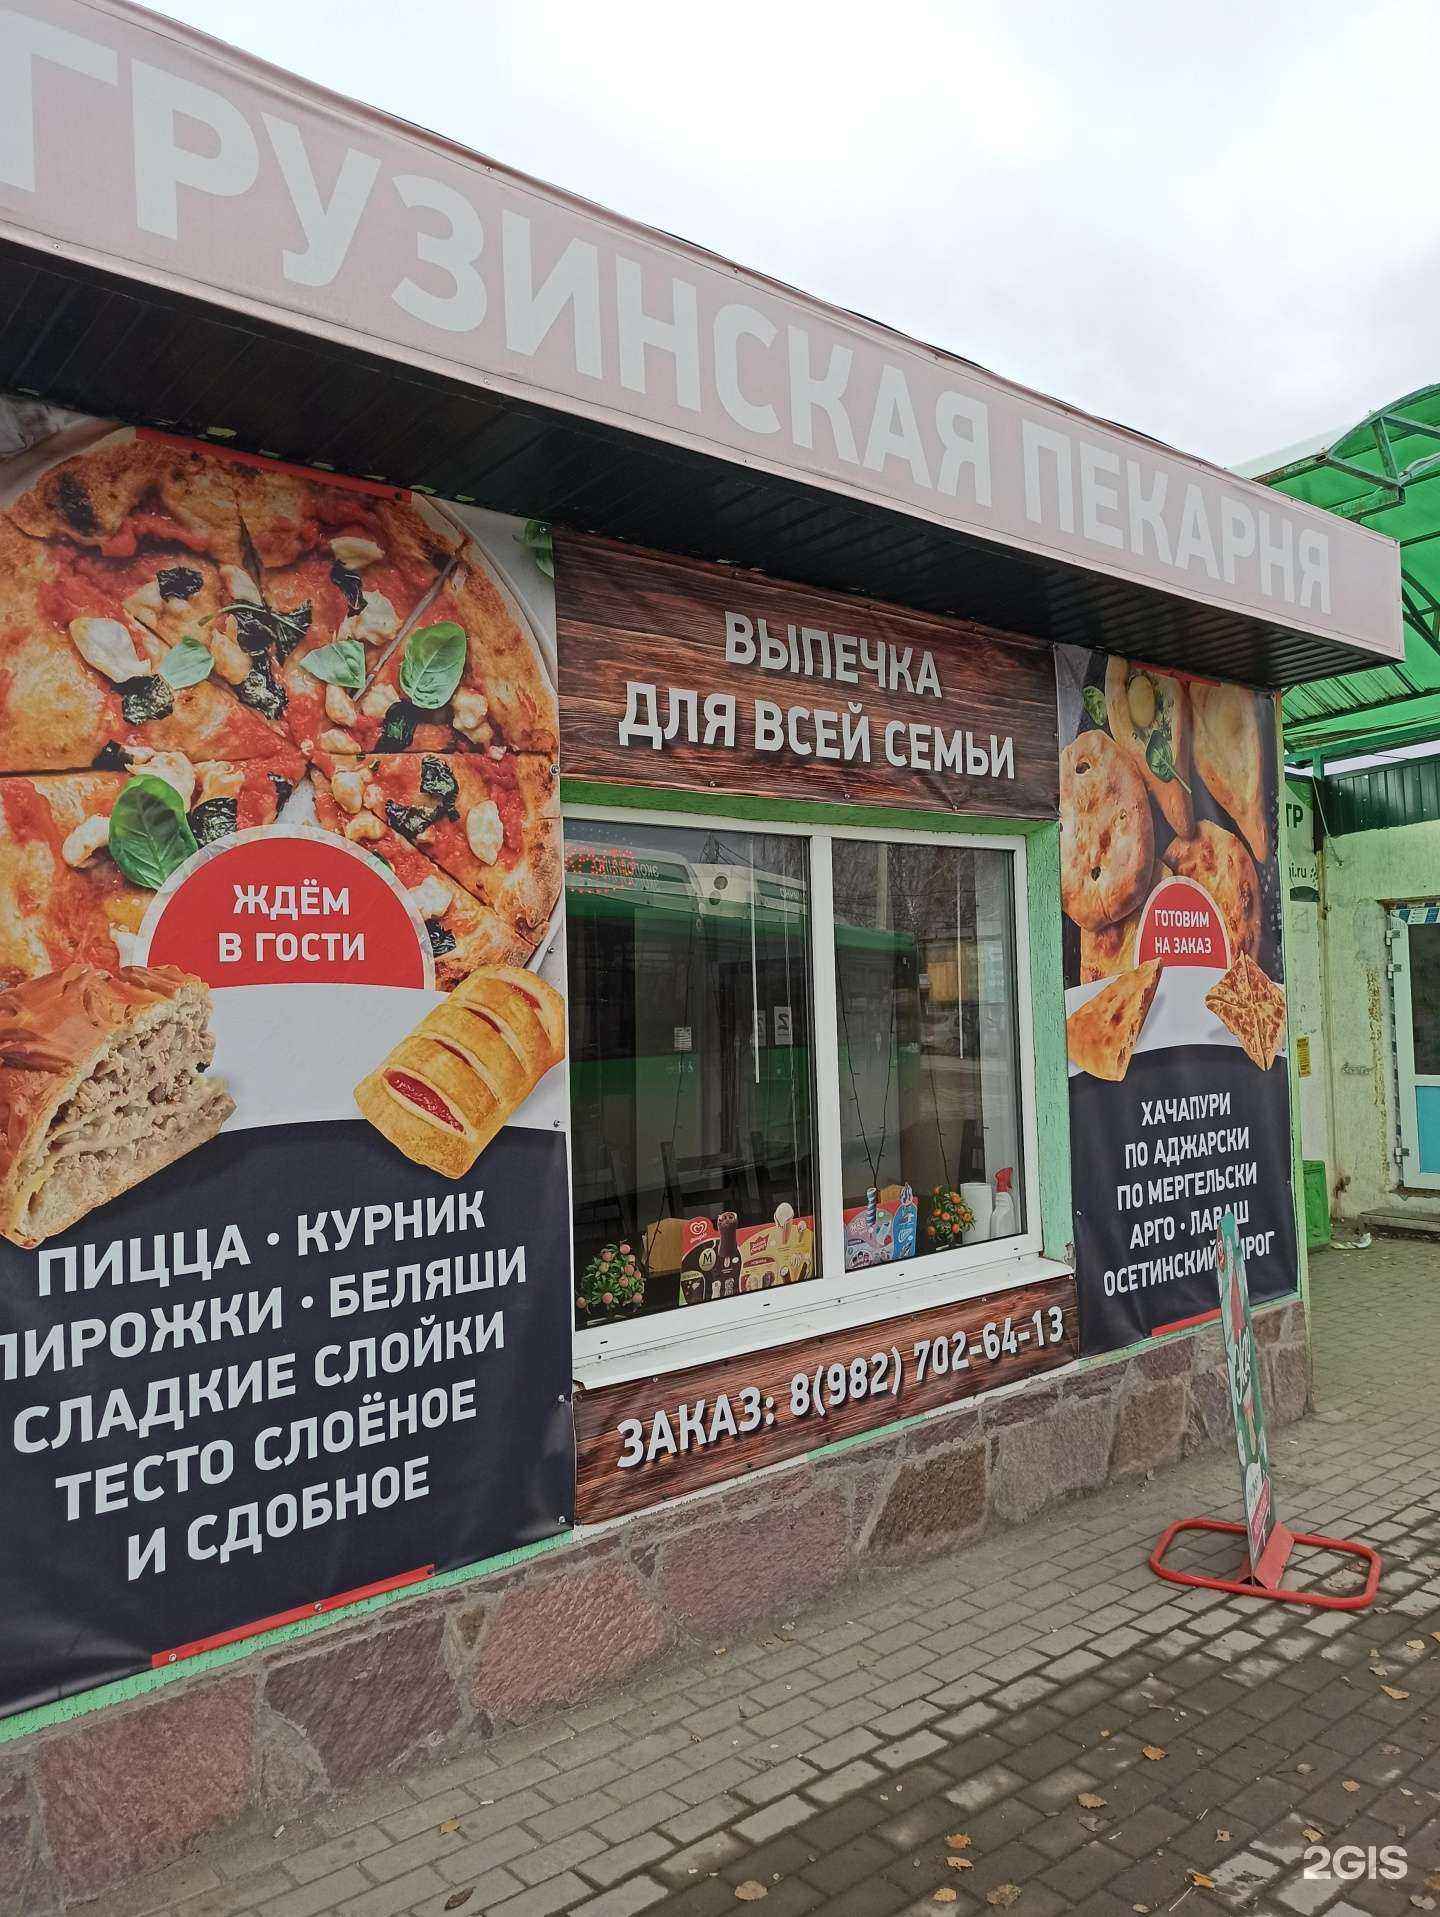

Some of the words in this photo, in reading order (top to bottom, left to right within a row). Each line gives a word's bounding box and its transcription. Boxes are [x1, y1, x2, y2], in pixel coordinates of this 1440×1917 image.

[0, 9, 991, 507] ГРУЗИНСКАЯ
[1021, 417, 1333, 615] ПЕКАРНЯ
[725, 611, 942, 698] ВЫПЕЧКА
[618, 681, 737, 750] ДЛЯ
[754, 699, 871, 763] ВСЕЙ
[885, 720, 1015, 779] СЕМЬИ
[232, 878, 350, 921] ЖДЁМ
[1154, 909, 1210, 928] ГОТОВИМ
[218, 932, 242, 962] В
[255, 932, 365, 962] ГОСТИ
[1154, 936, 1171, 954] НА
[1173, 936, 1212, 954] ЗАКАЗ
[1141, 1092, 1231, 1126] ХАЧАПУРИ
[1125, 1142, 1148, 1169] ПО
[1153, 1127, 1249, 1167] АДЖАРСКИ
[1117, 1183, 1143, 1211] ПО
[1148, 1162, 1257, 1205] МЕРГЕЛЬСКИ
[38, 1224, 251, 1296] ПИЦЦА
[298, 1190, 485, 1255] КУРНИК
[1130, 1216, 1175, 1249] АРГО
[329, 1245, 527, 1318] БЕЛЯШИ
[1103, 1239, 1218, 1296] ОСЕТИНСКИЙ
[13, 1353, 297, 1453] СЛАДКИЕ
[314, 1310, 505, 1387] СЛОЙКИ
[616, 1386, 774, 1468] ЗАКАЗ:
[789, 1347, 903, 1416] 8(982)
[914, 1306, 1064, 1381] 702-64-13
[55, 1439, 234, 1521] ТЕСТО
[254, 1379, 477, 1472] СЛОЁНОЕ
[127, 1527, 167, 1582] И
[187, 1455, 430, 1563] СДОБНОЕ
